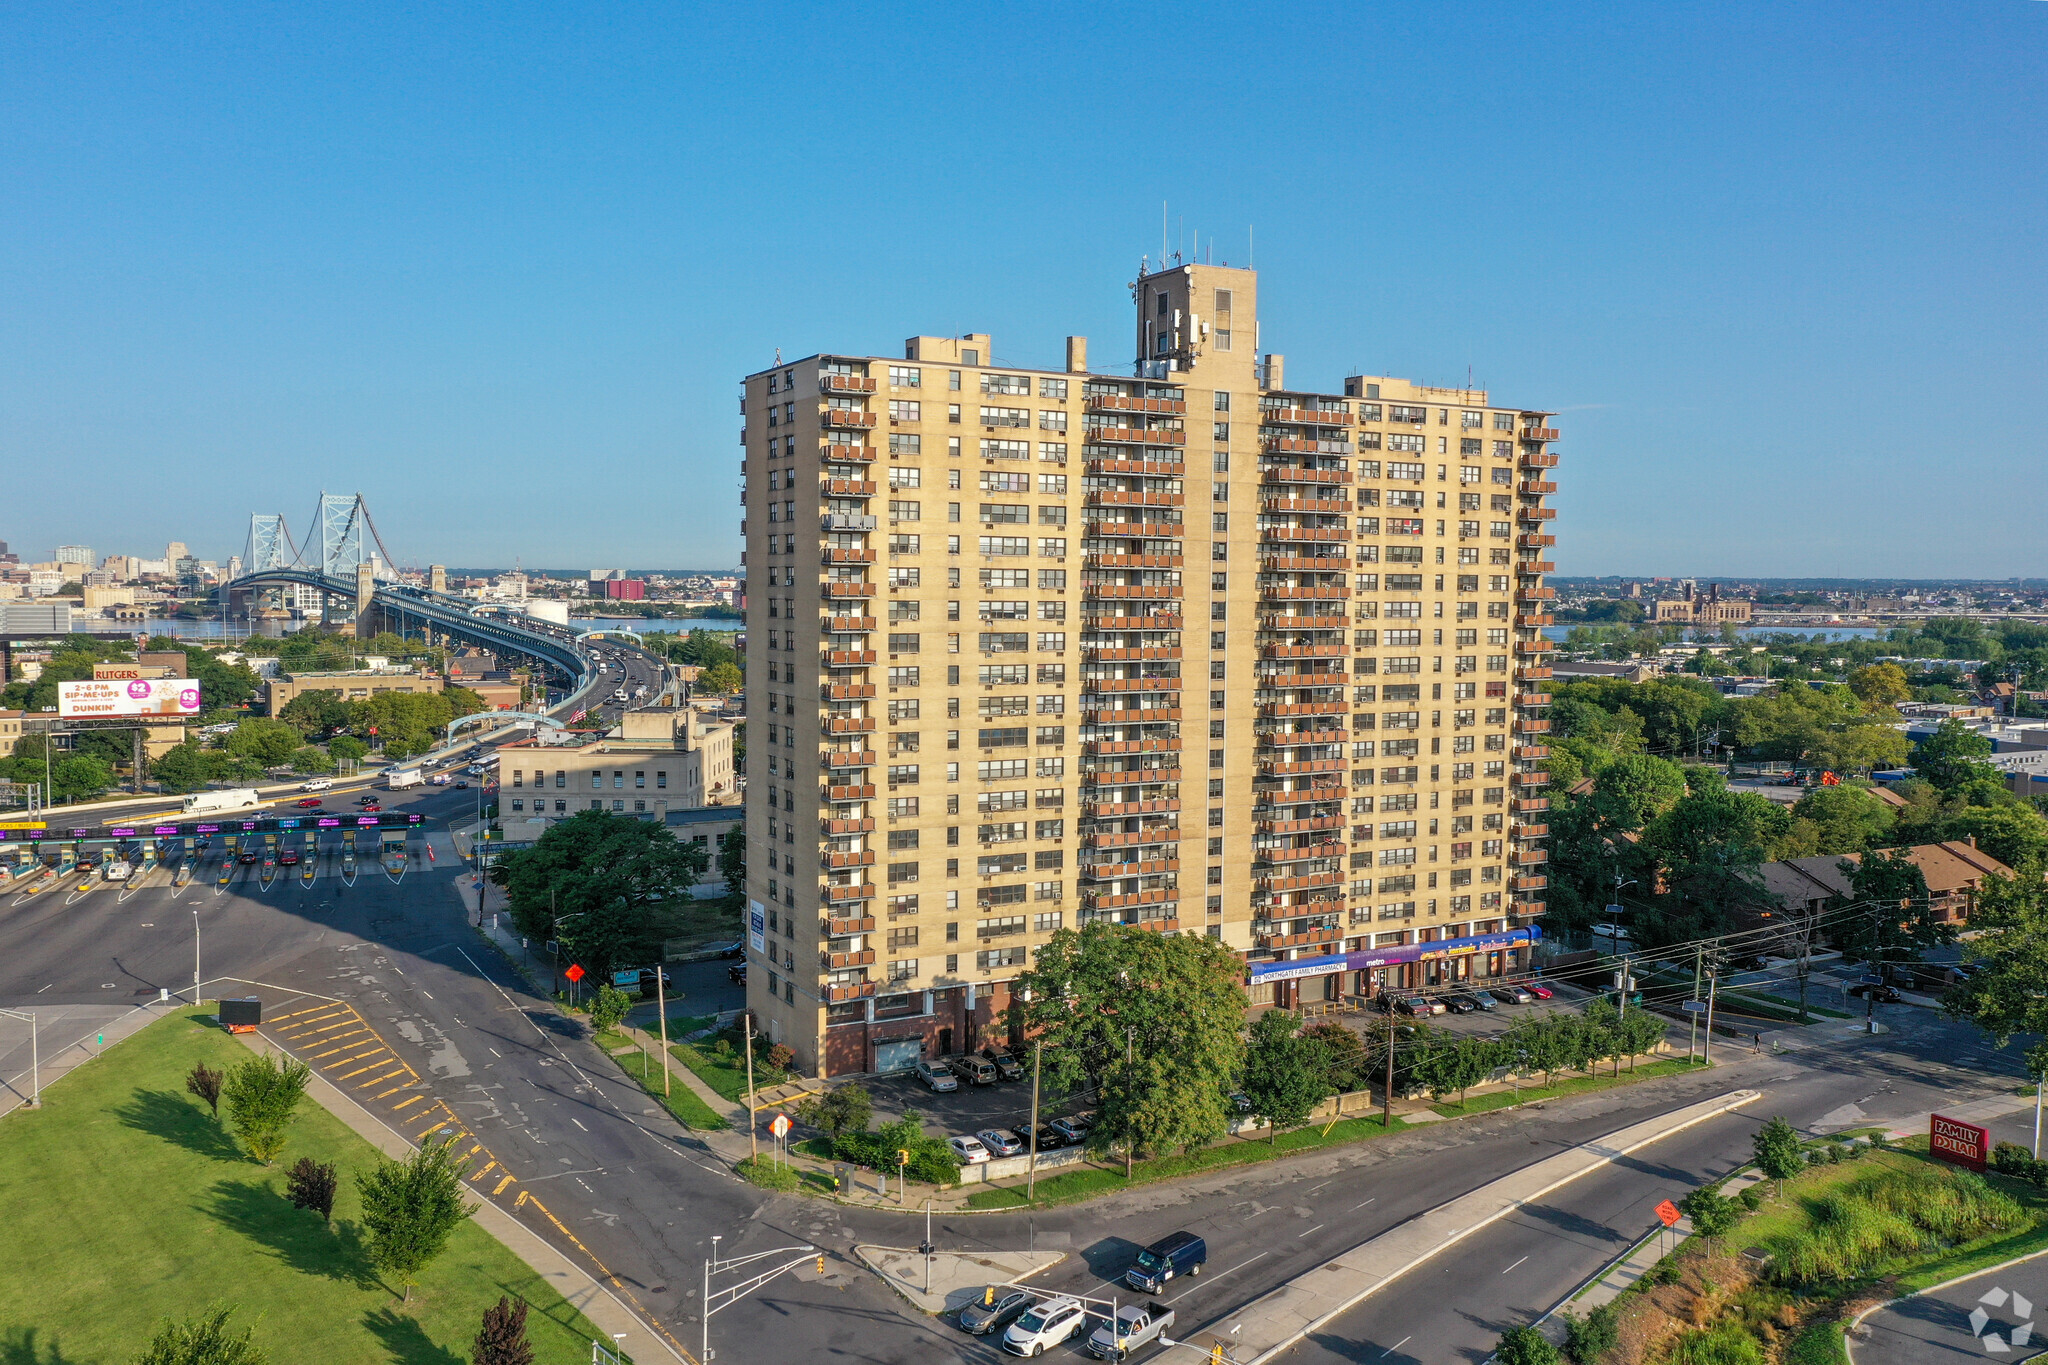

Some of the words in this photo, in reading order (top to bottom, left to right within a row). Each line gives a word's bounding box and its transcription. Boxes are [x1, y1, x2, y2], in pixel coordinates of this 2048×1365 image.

[96, 670, 138, 679] RUTGERS
[131, 682, 146, 692] $2
[182, 692, 197, 700] $3
[1264, 969, 1294, 981] NORTHGATE
[1295, 967, 1314, 976] FAMILY
[1314, 963, 1342, 973] PHARMACY
[1935, 1120, 1979, 1144] FAMILY
[1934, 1134, 1977, 1158] DOLLAR
